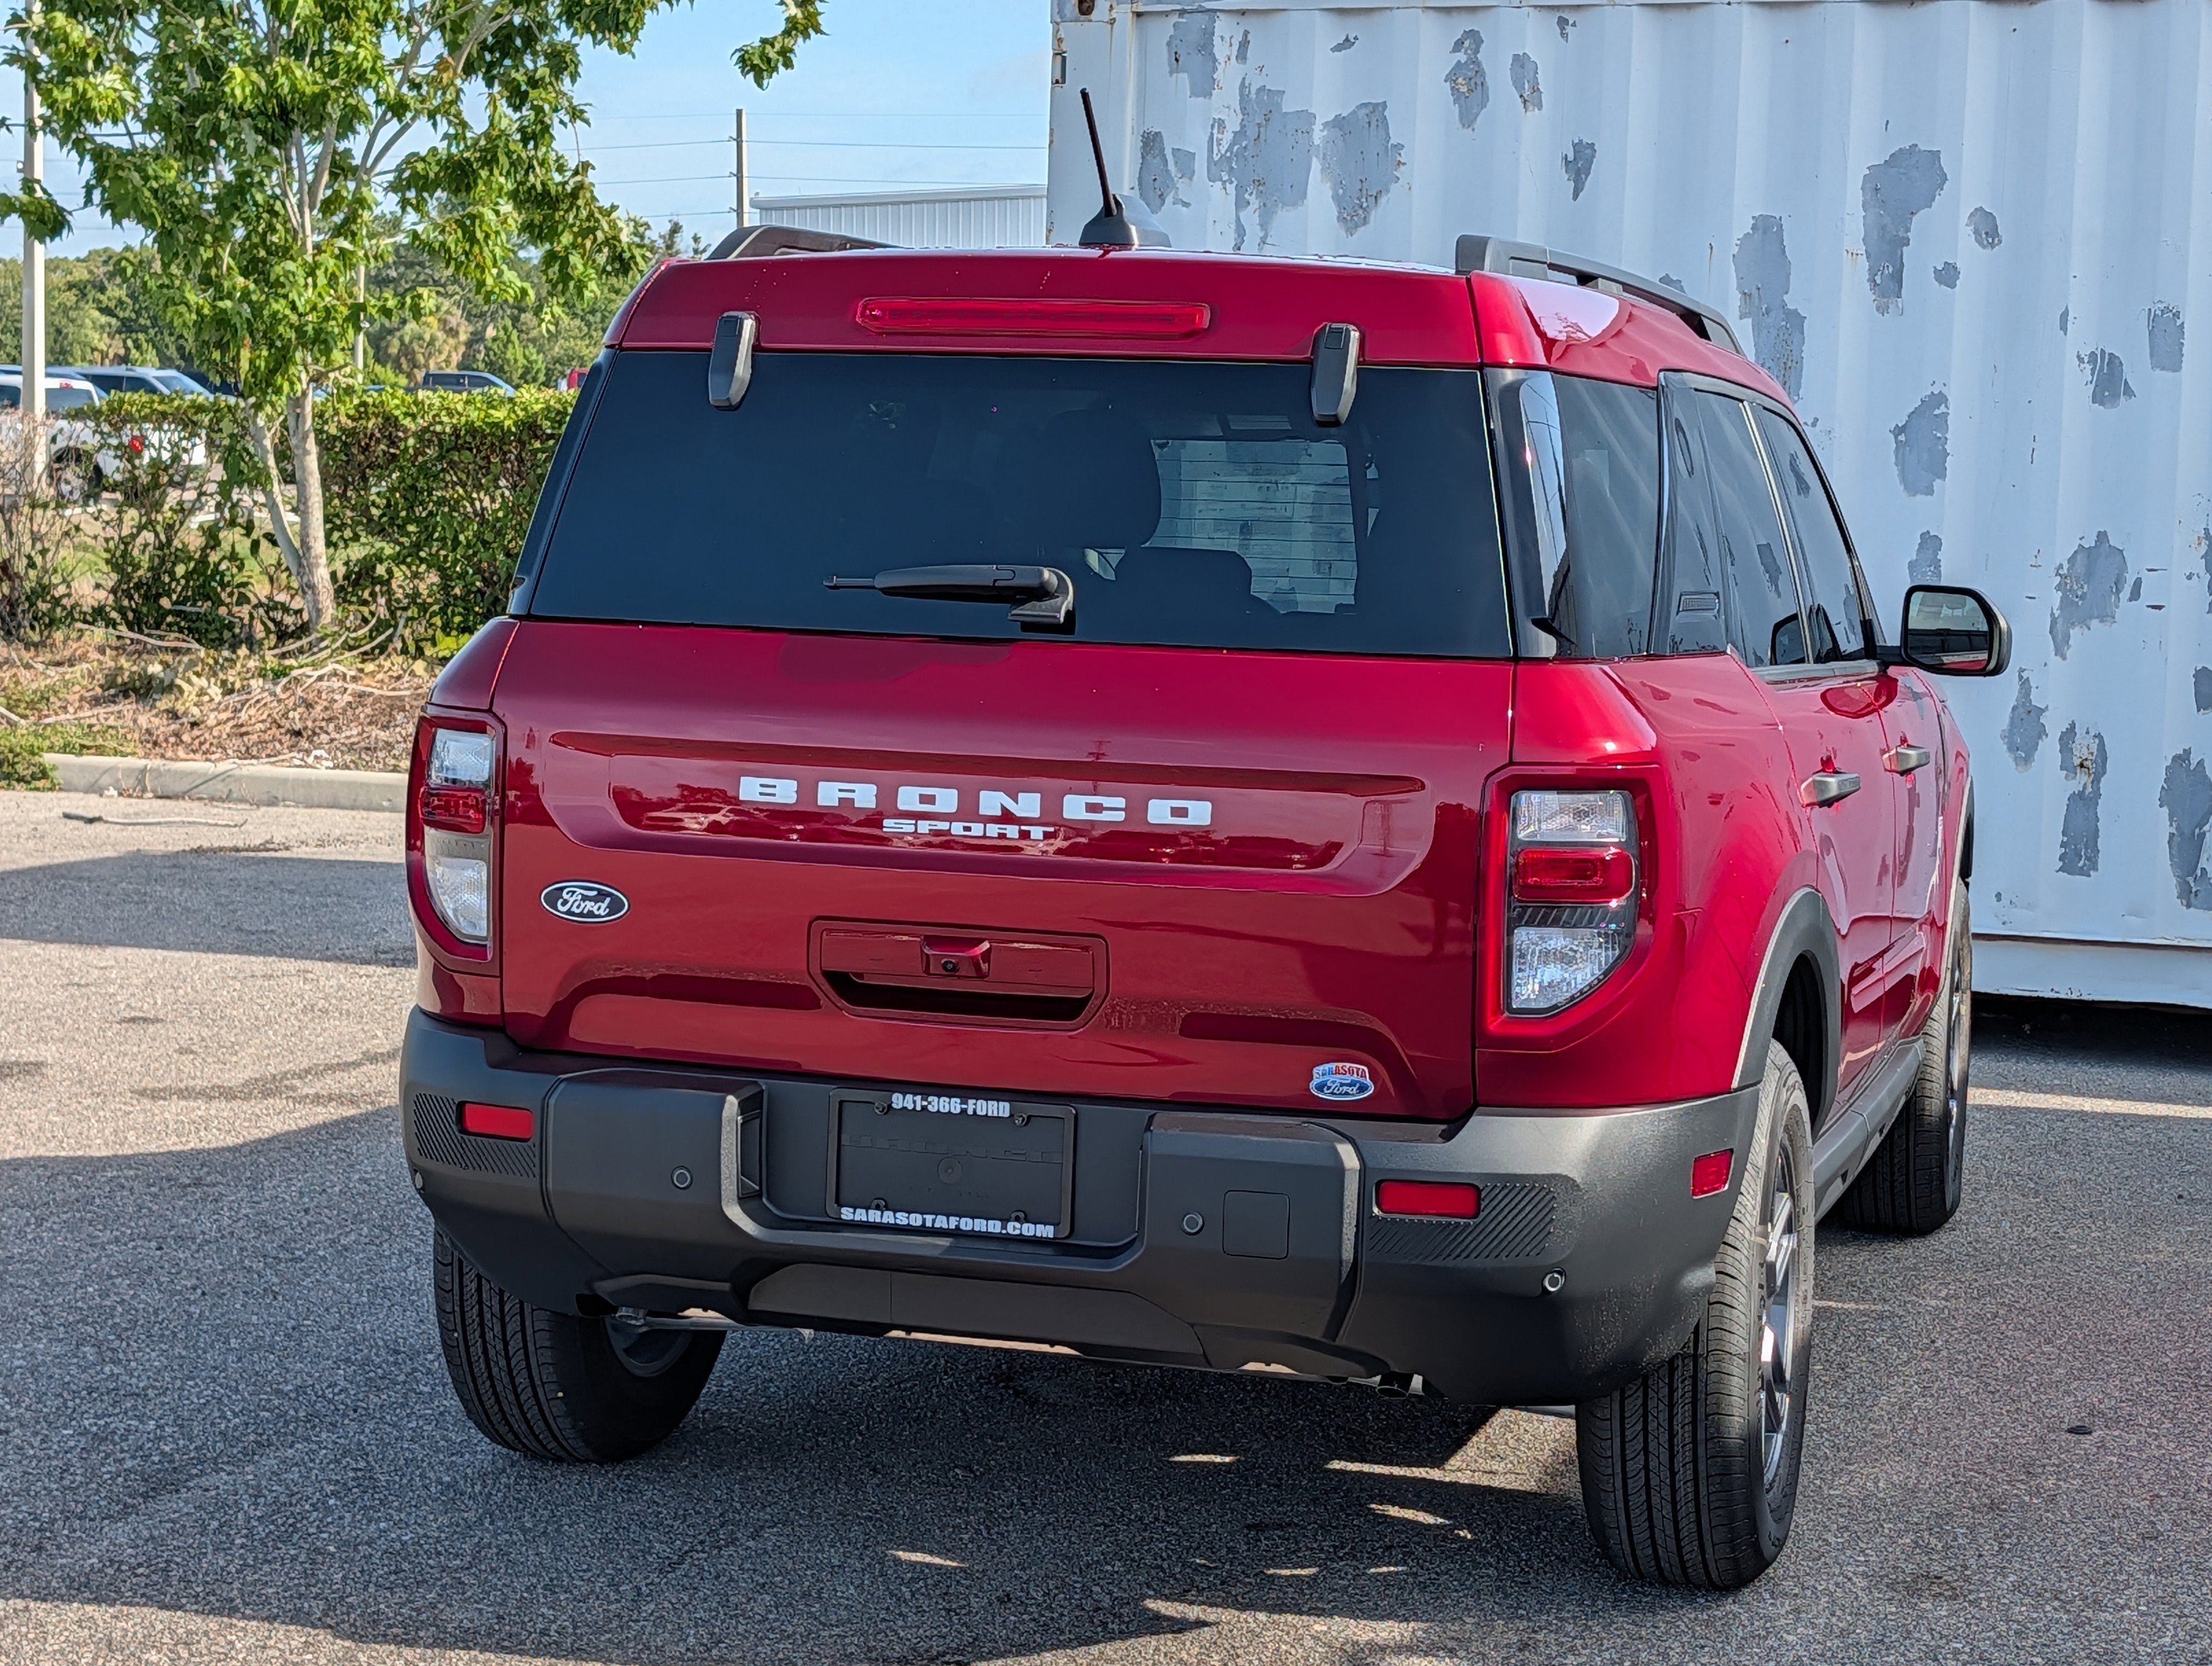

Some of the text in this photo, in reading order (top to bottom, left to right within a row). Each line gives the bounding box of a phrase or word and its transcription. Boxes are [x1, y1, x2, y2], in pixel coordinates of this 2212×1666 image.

[738, 776, 1212, 826] BRONCO
[882, 819, 1057, 841] SPORT
[557, 887, 611, 916] Ford
[1315, 1065, 1367, 1079] SARASOTA
[1323, 1078, 1360, 1095] Ford
[892, 1092, 1010, 1118] 941-366-FORD
[840, 1207, 1054, 1239] SARASOTAFORD.COM
